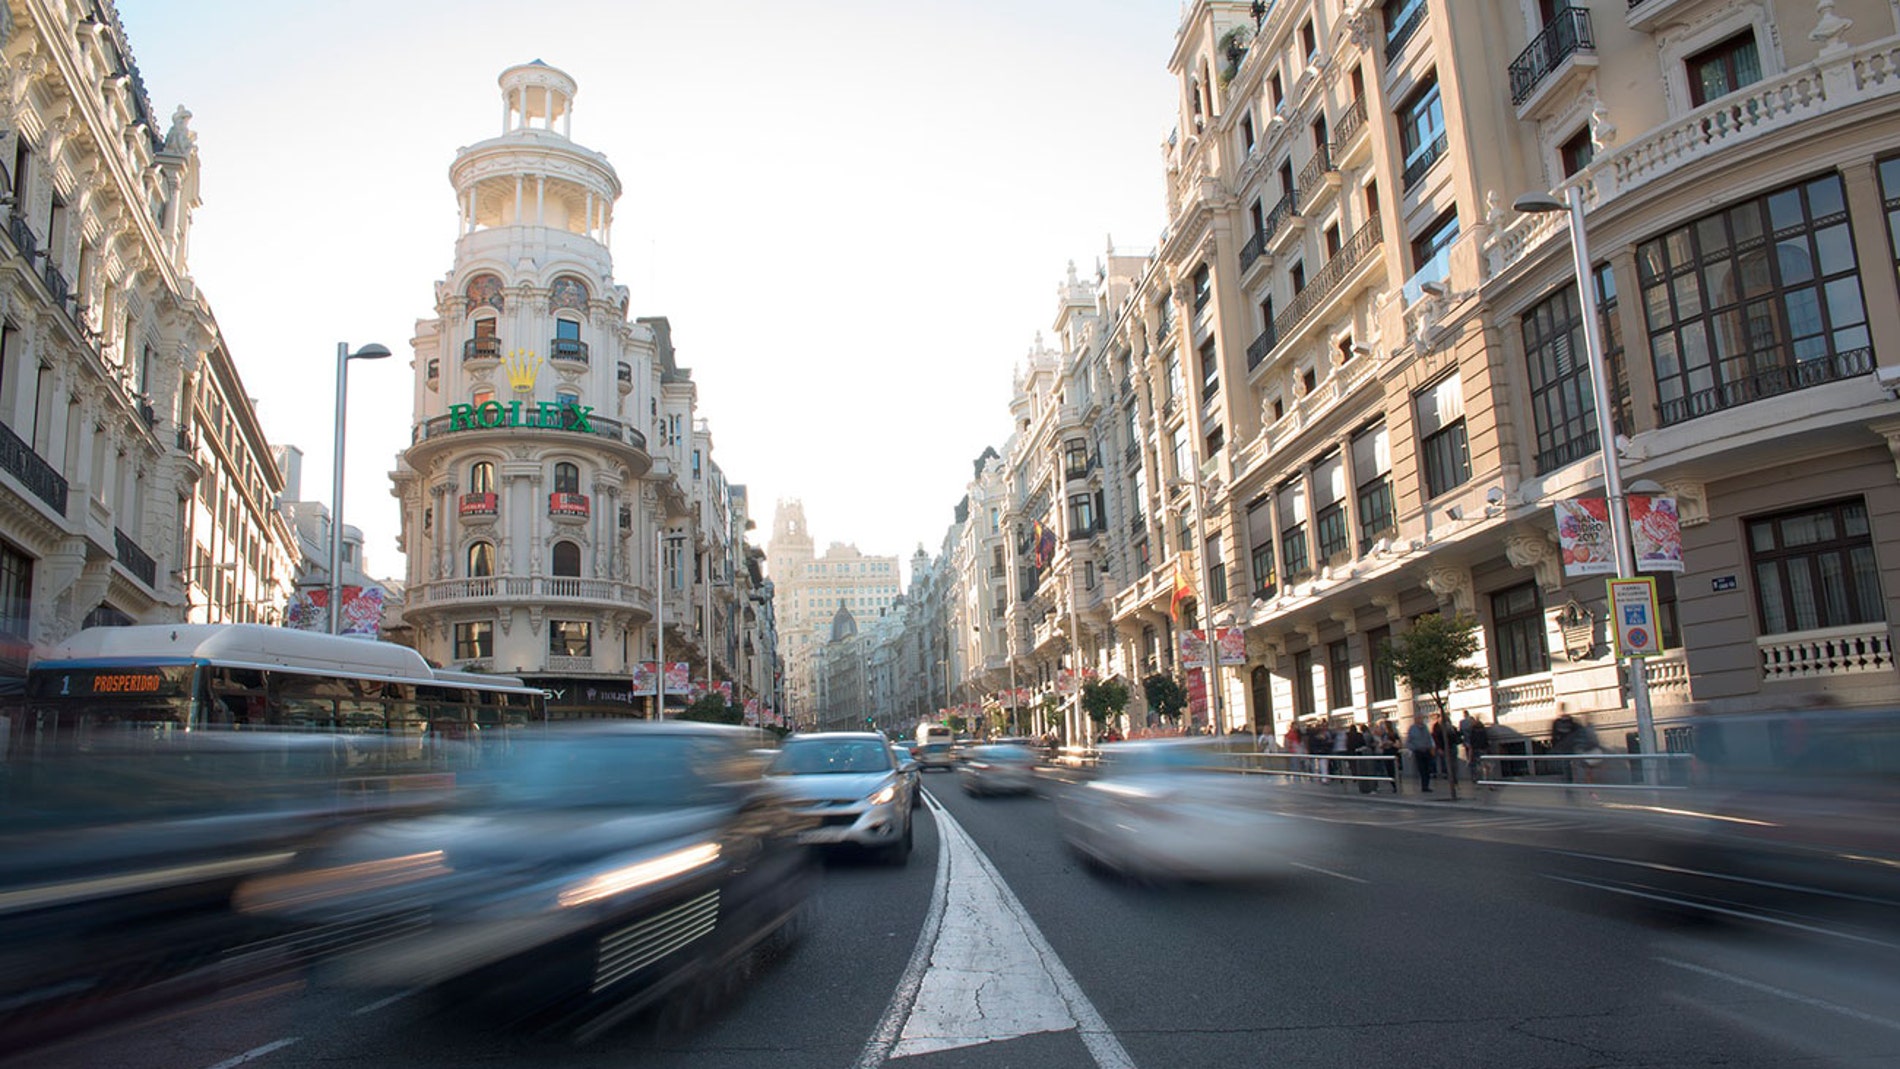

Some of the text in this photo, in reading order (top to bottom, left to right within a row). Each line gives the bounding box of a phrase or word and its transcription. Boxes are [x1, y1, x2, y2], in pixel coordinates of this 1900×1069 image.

[448, 400, 595, 432] ROLEX
[1577, 532, 1600, 542] 2017
[60, 675, 159, 695] 1 PROSPERIDAD
